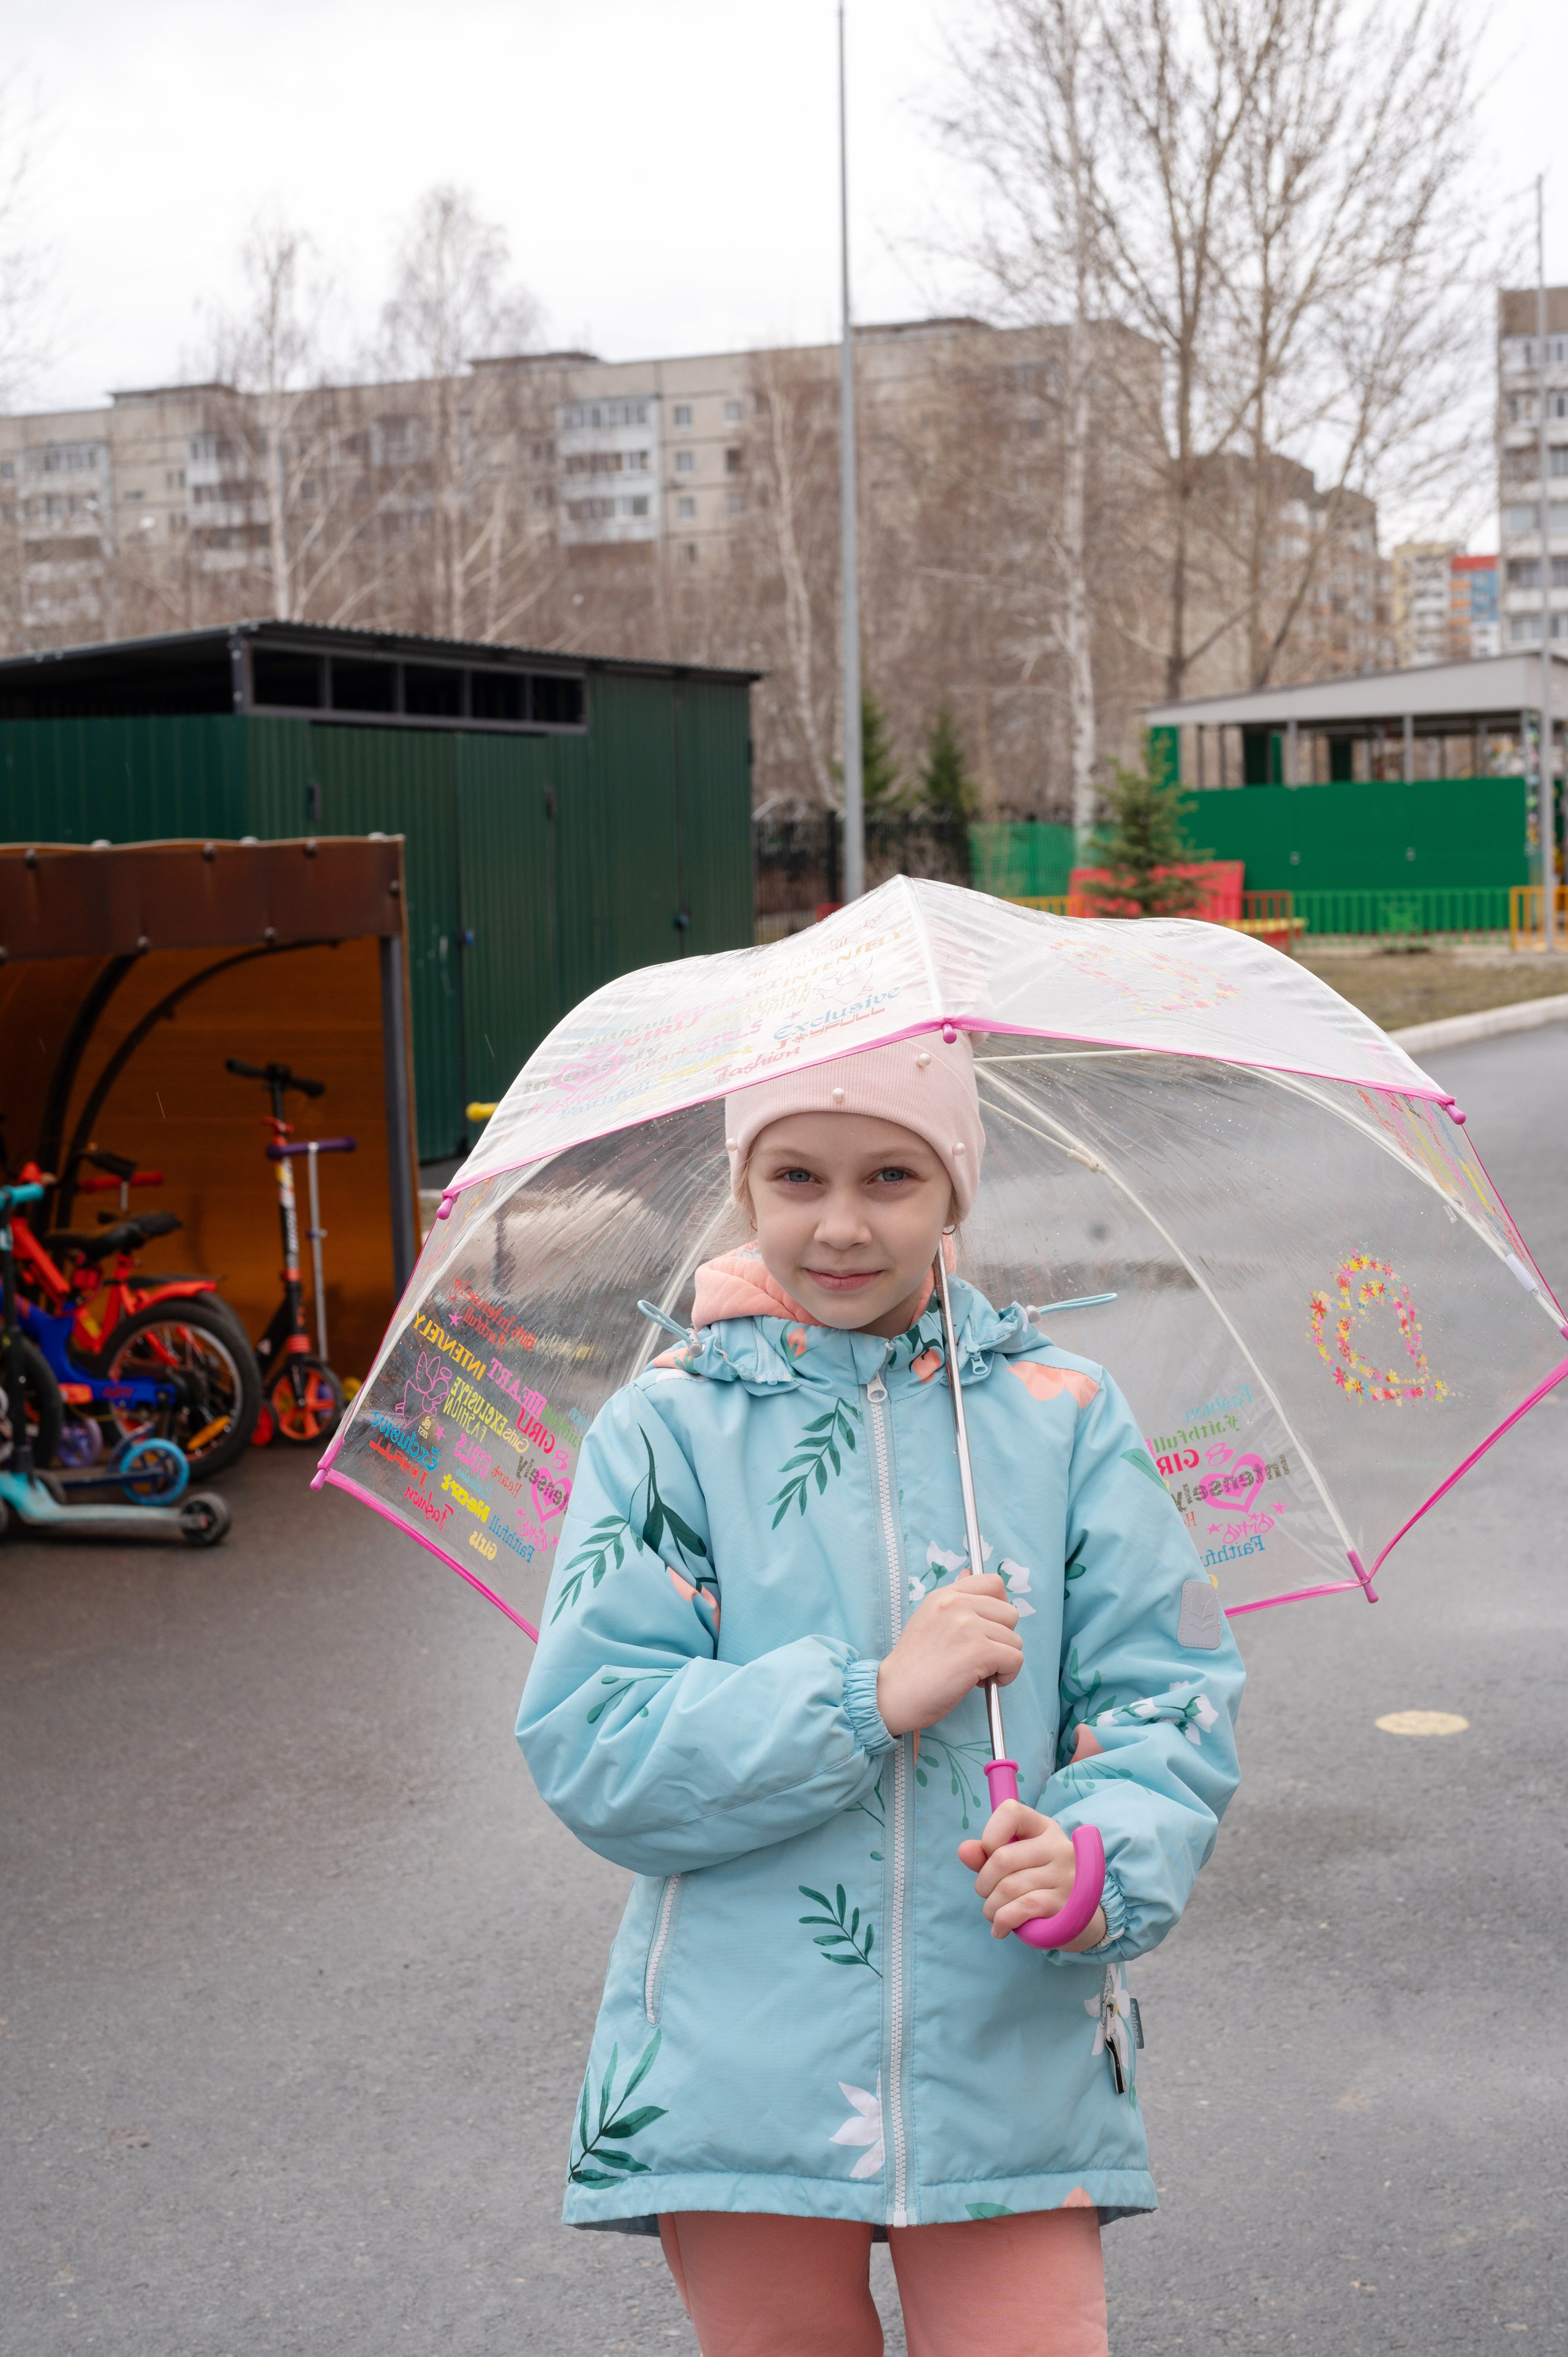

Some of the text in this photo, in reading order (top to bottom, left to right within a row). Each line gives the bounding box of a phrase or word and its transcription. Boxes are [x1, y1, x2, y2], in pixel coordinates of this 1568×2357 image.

[782, 931, 901, 987] INTENSELY
[623, 1015, 701, 1047] GIRLS
[774, 987, 901, 1041] Exclusive
[712, 1047, 801, 1084] Fashion
